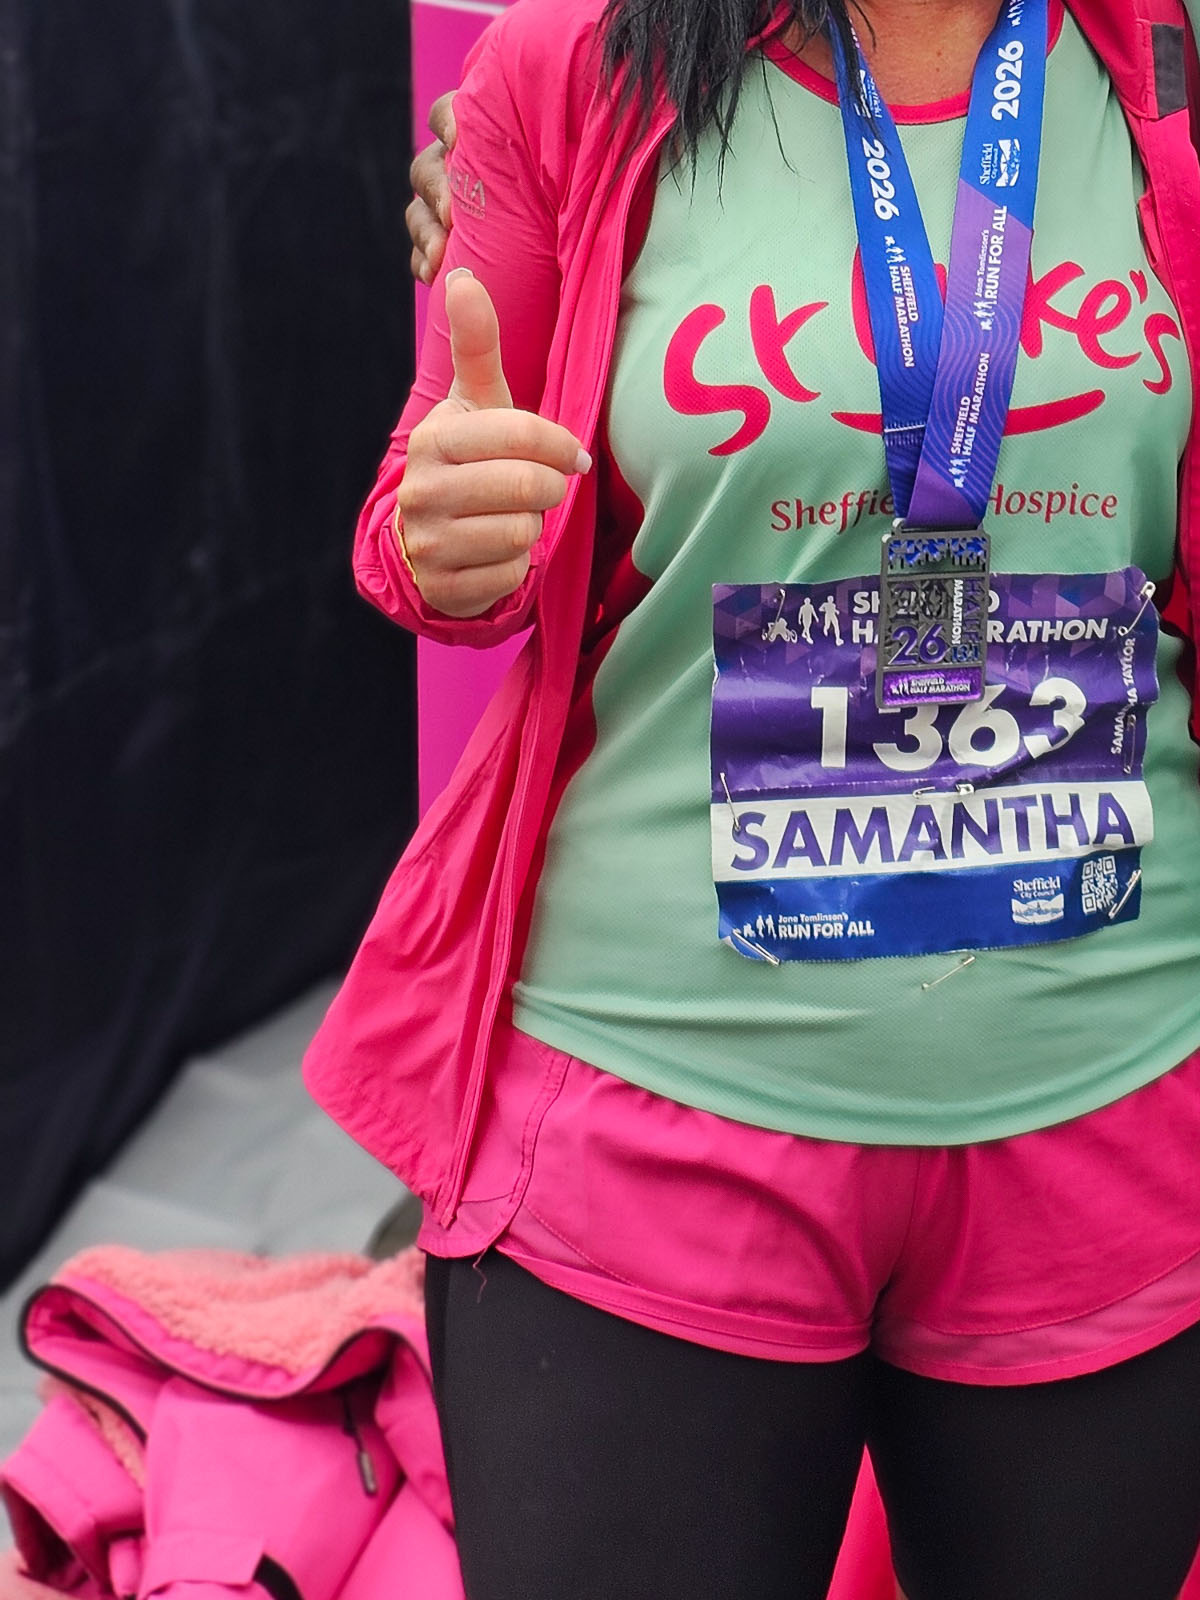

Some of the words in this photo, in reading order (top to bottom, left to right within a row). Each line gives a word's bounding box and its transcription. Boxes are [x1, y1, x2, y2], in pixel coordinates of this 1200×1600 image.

[991, 39, 1025, 122] 2026
[862, 136, 901, 222] 2026
[978, 142, 994, 186] Sheffield
[992, 205, 1008, 233] ALL
[977, 228, 990, 277] Tomlinson's
[988, 234, 1005, 265] FOR
[888, 264, 904, 296] HALF
[899, 264, 920, 322] SHEFFIELD
[975, 277, 985, 298] Jane
[984, 266, 1001, 299] RUN
[894, 295, 916, 369] MARATHON
[663, 283, 829, 457] St
[968, 351, 991, 425] MARATHON
[950, 395, 971, 456] SHEFFIELD
[961, 424, 977, 457] HALF
[769, 494, 895, 533] Sheffie
[951, 578, 965, 646] MARATHON
[986, 618, 1109, 644] RATHON
[887, 623, 947, 666] 26
[1119, 637, 1136, 687] TAYLOR
[928, 682, 971, 695] MARATHON
[810, 677, 1087, 772] 1363
[730, 791, 1137, 871] SAMANTHA
[1012, 875, 1061, 892] Sheffield
[777, 914, 799, 924] Jane
[799, 911, 849, 923] Tomlinson's
[777, 923, 811, 940] RUN
[813, 922, 844, 939] FOR
[847, 920, 875, 938] ALL
